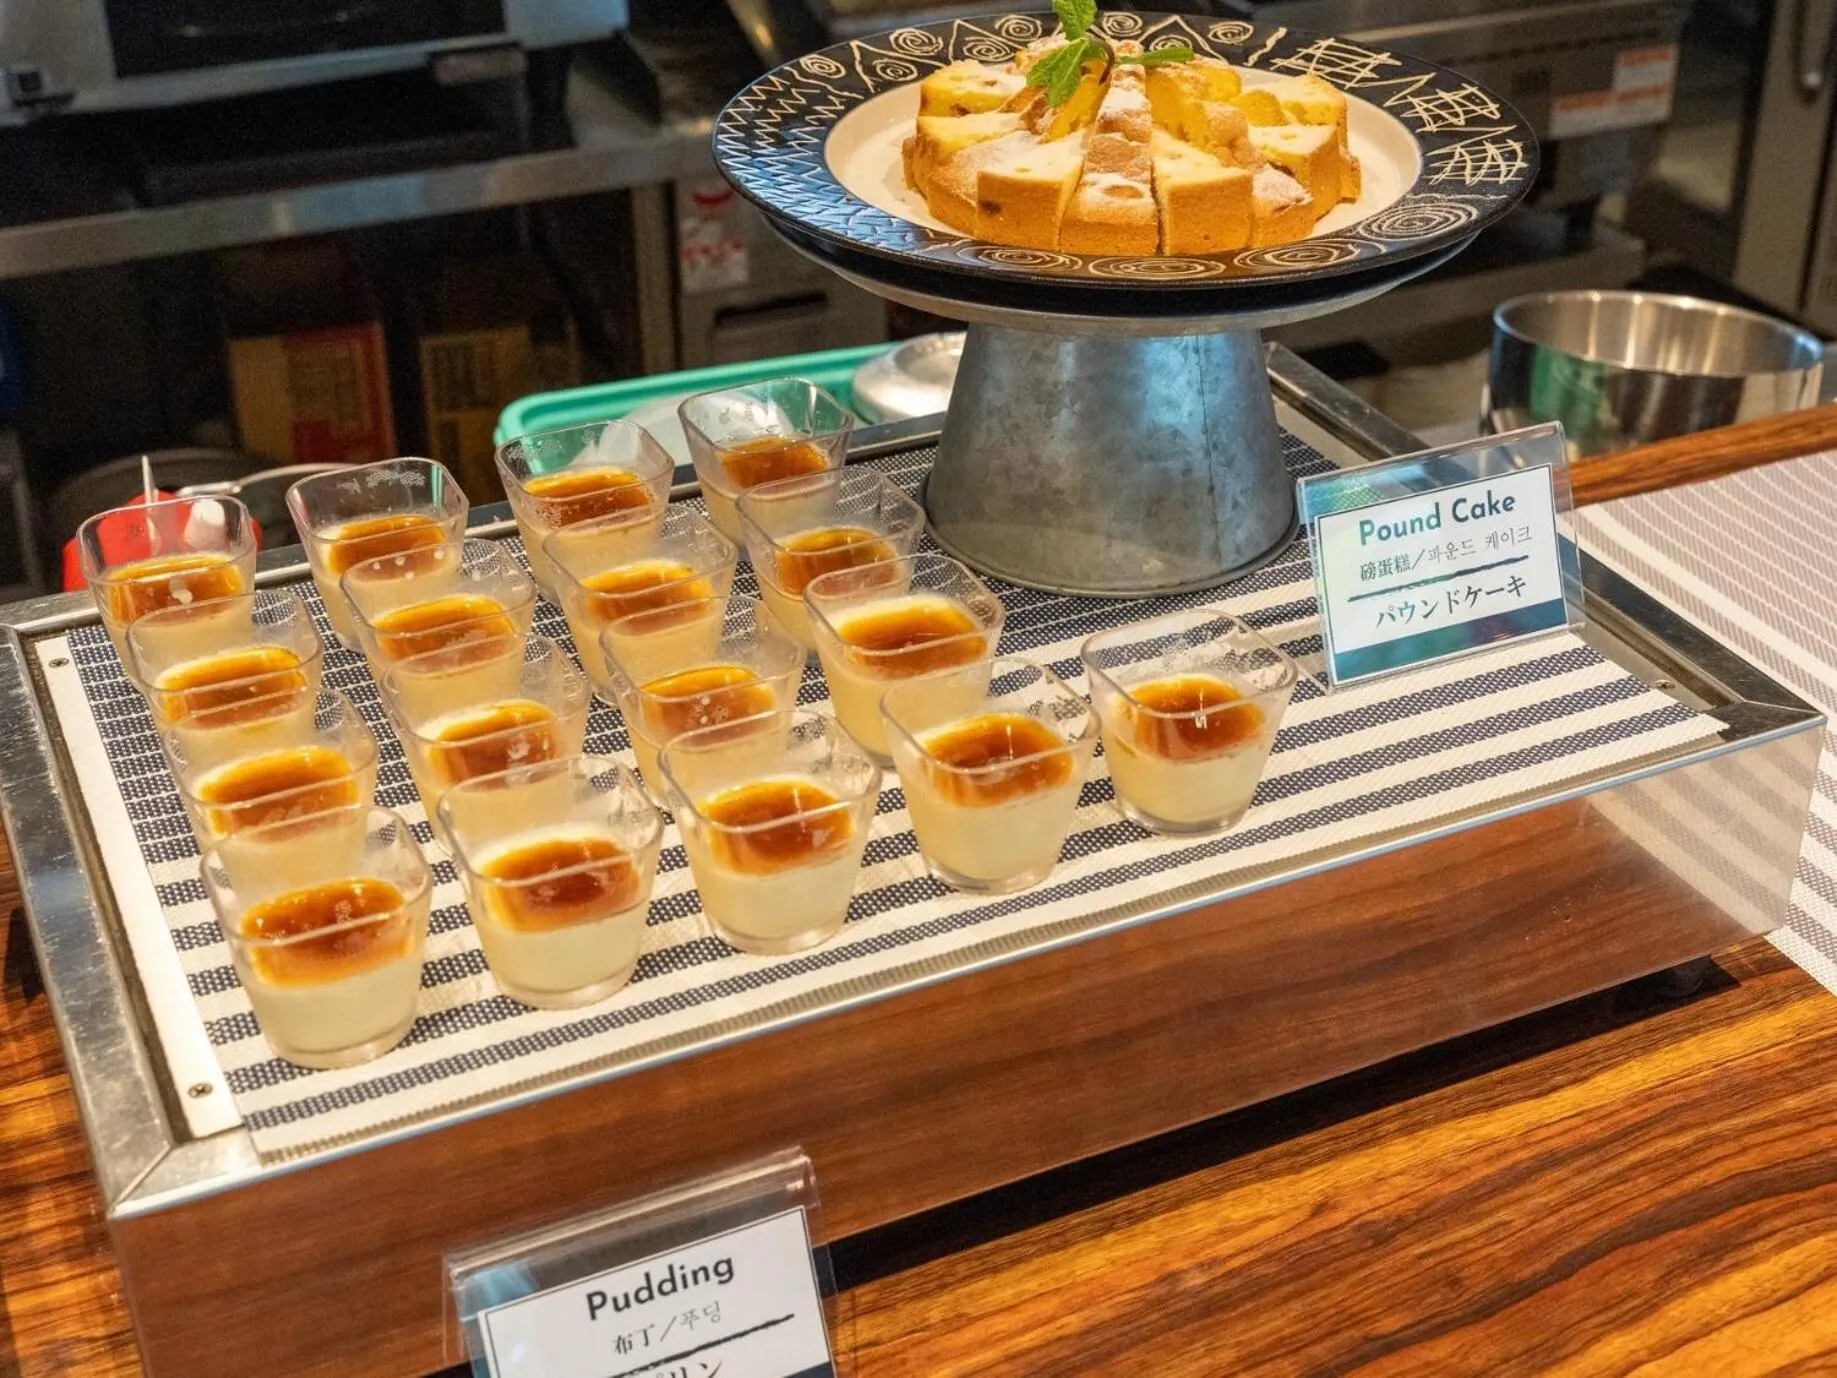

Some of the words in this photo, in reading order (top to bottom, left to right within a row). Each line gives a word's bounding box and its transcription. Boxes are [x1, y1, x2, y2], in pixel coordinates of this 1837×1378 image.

[1359, 501, 1442, 546] Pound
[1452, 489, 1516, 523] Cake
[1485, 525, 1533, 550] 케이크
[1375, 574, 1527, 628] パウンドケーキ
[586, 1257, 734, 1321] Pudding
